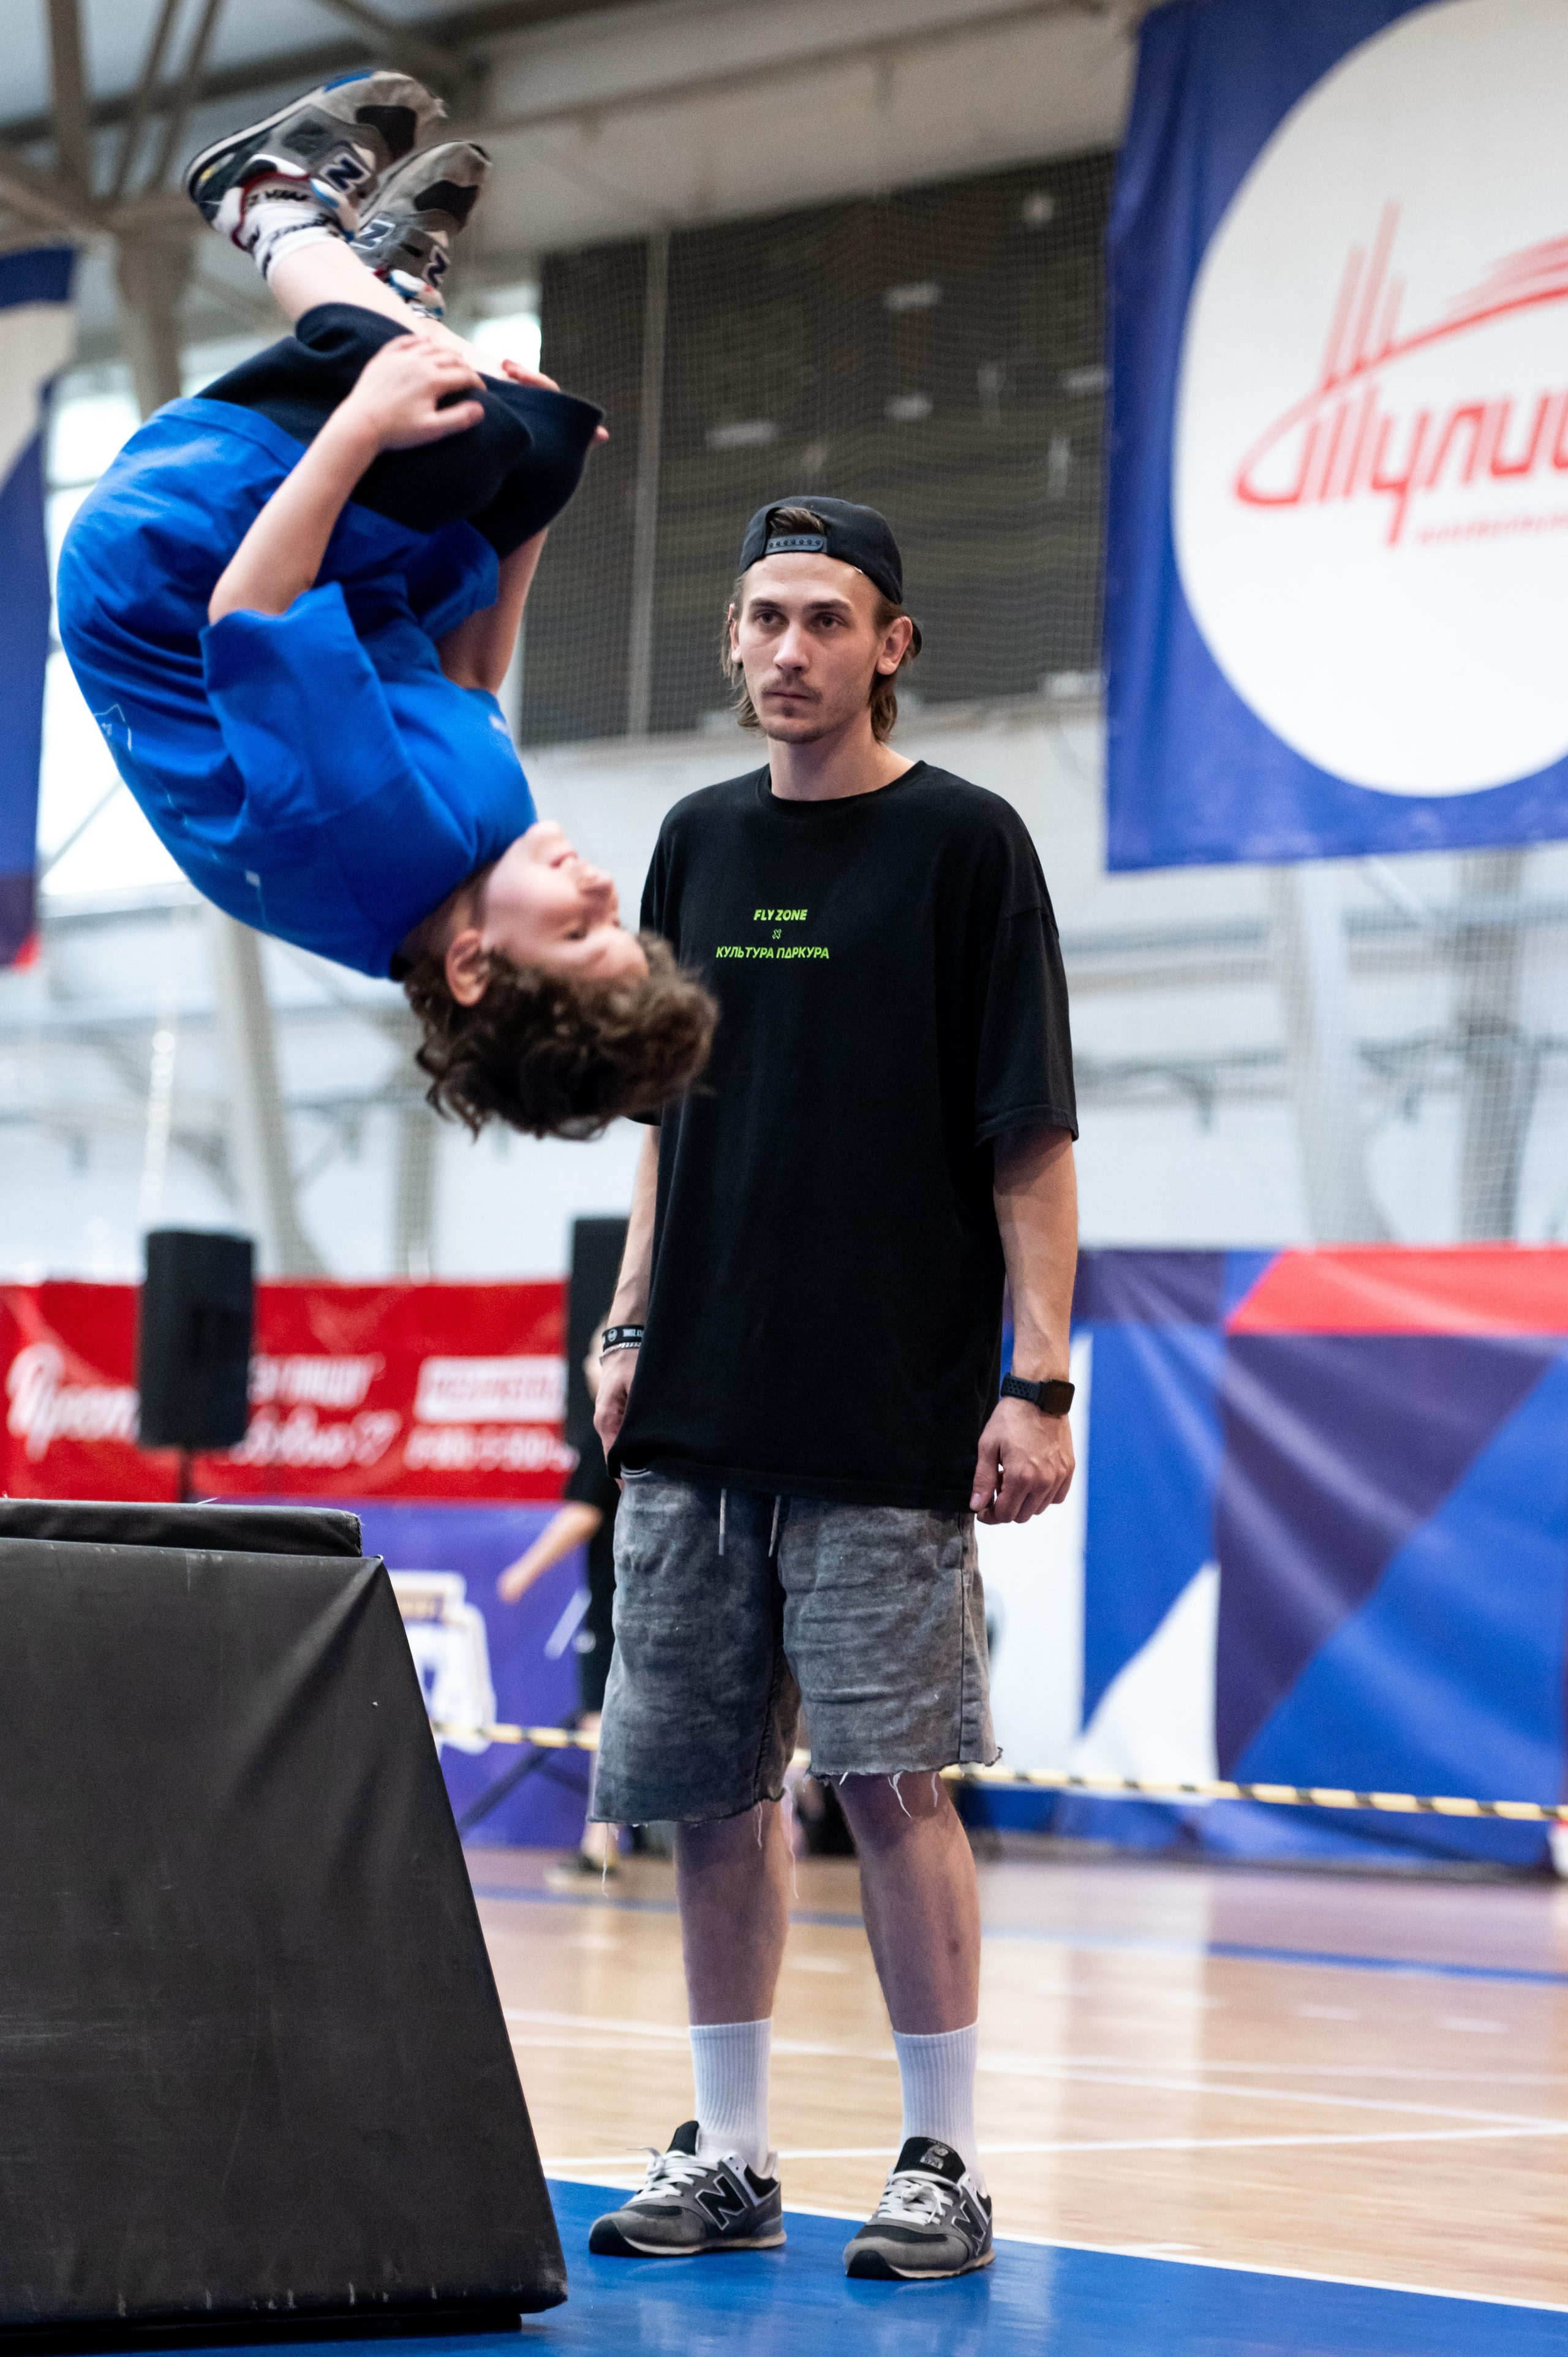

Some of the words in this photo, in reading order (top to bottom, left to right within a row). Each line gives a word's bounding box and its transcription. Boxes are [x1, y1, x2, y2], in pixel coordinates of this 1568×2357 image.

[753, 909, 774, 921] FLY
[775, 909, 807, 921] ZONE
[715, 946, 774, 959] КУЛЬТУРА
